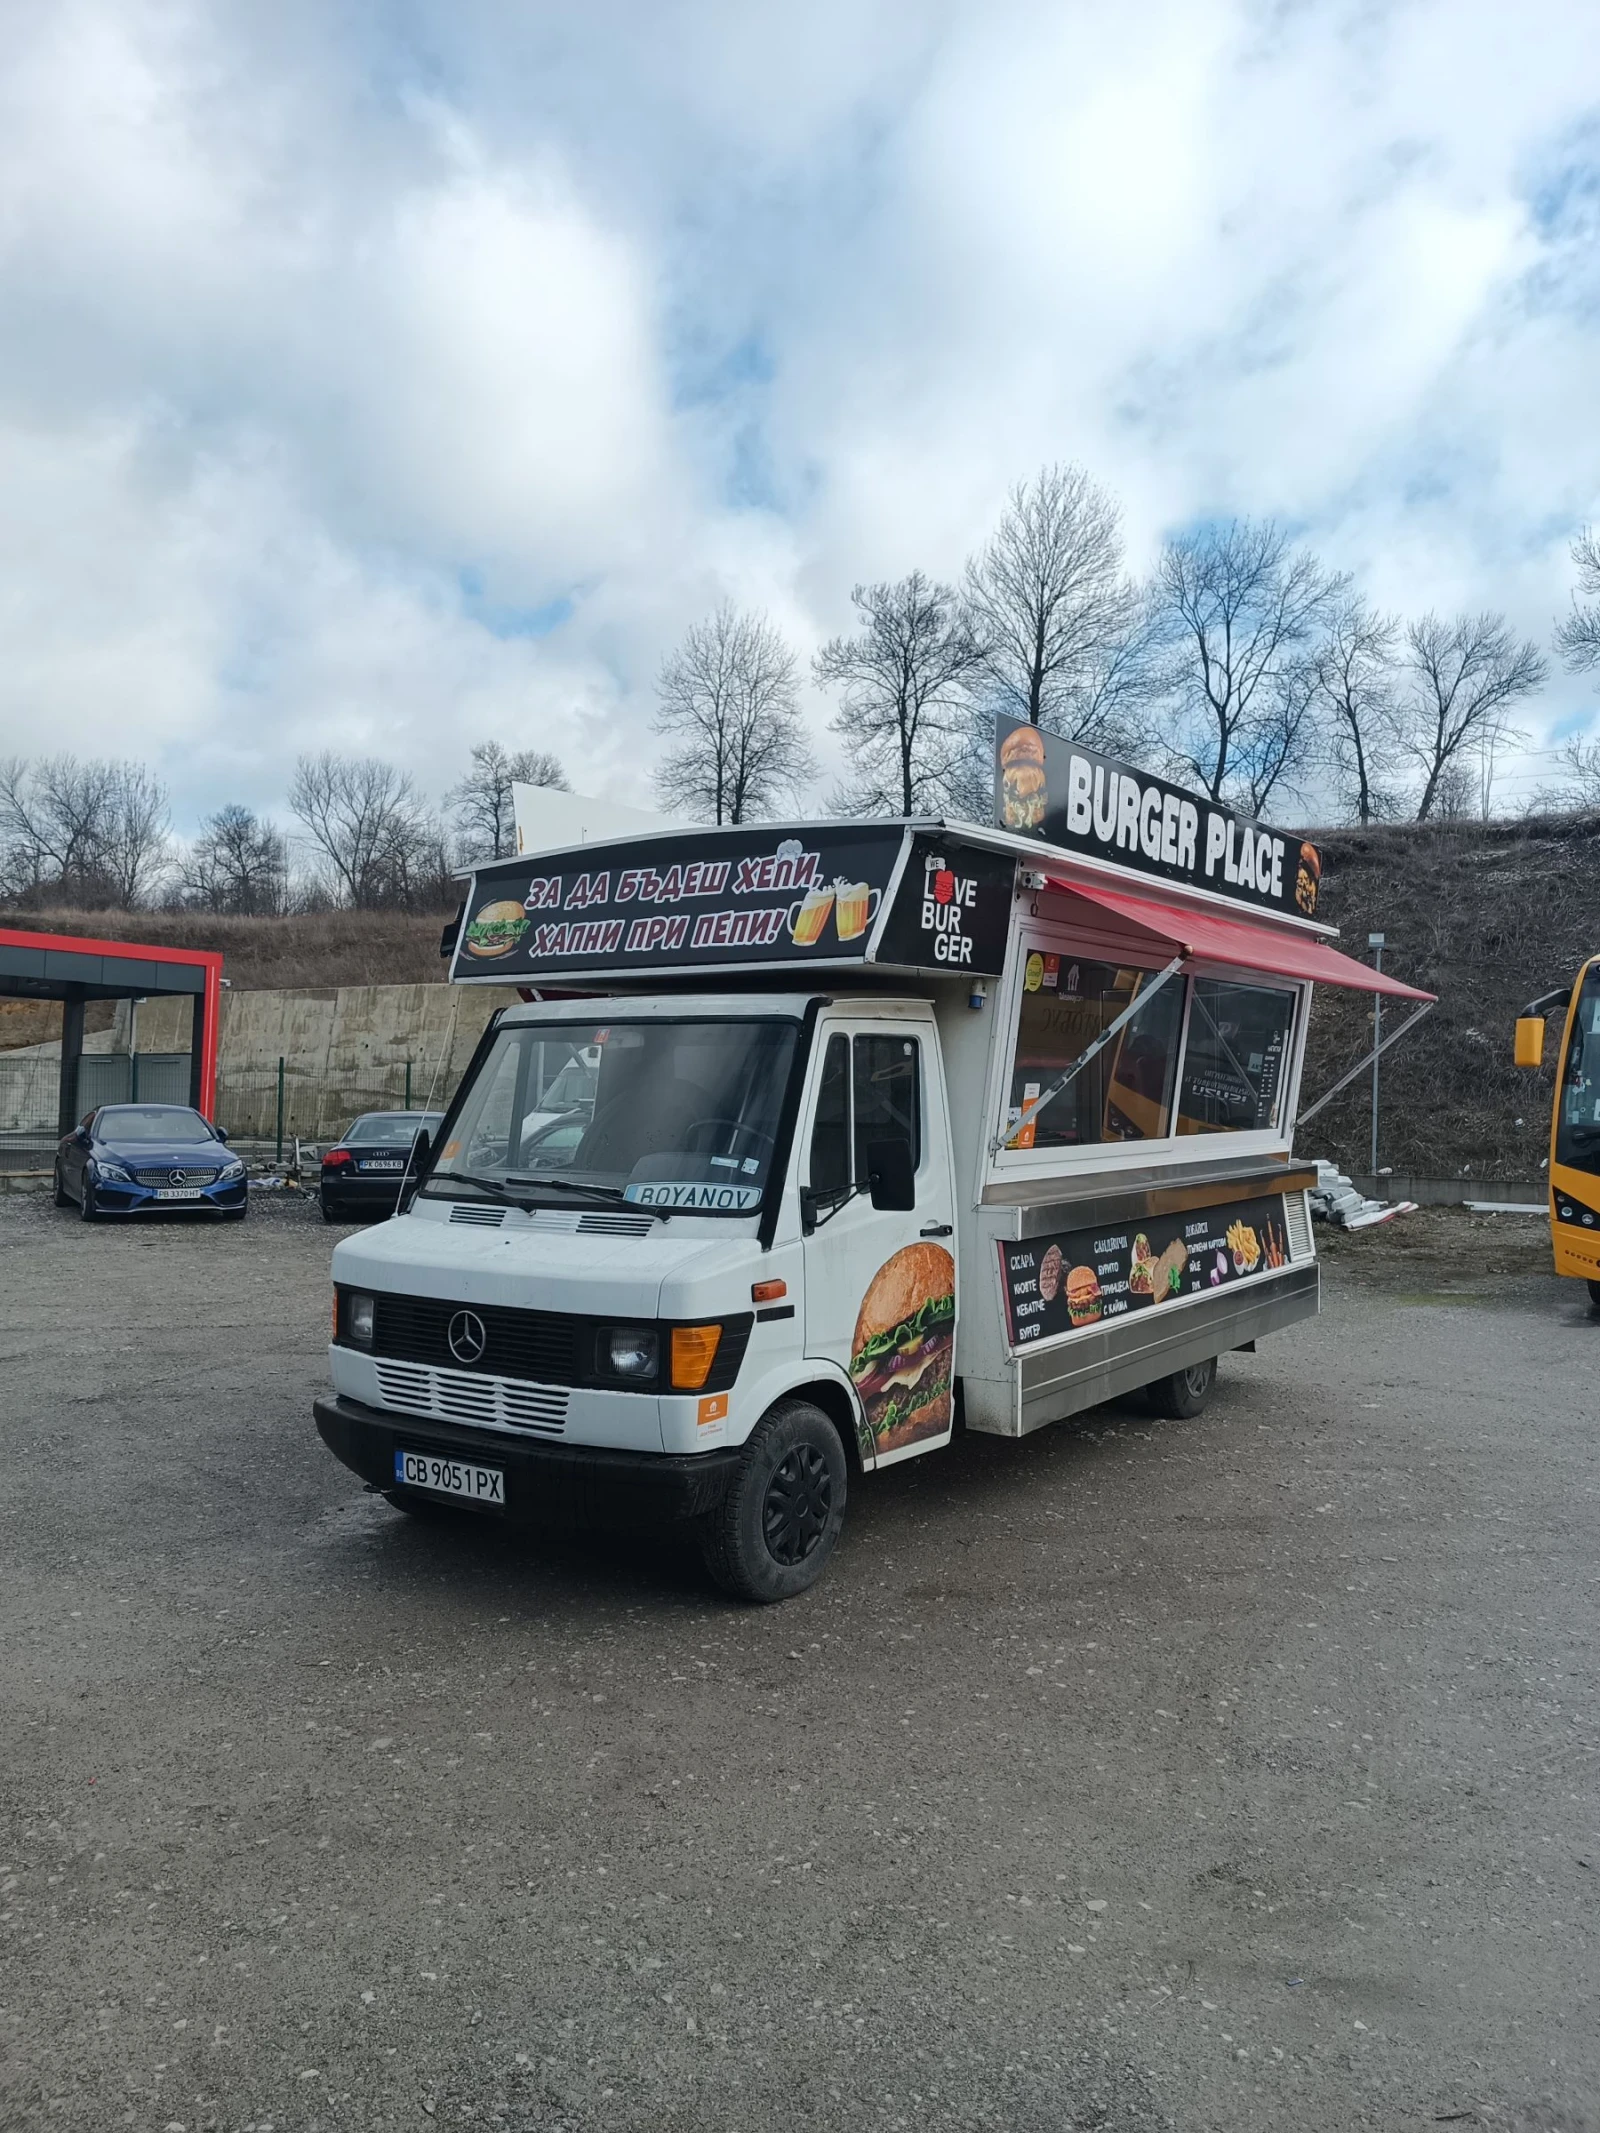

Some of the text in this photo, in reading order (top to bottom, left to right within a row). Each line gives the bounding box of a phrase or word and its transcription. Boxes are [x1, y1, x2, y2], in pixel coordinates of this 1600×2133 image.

[1067, 754, 1285, 898] BURGER PLACE
[930, 860, 939, 868] WE
[523, 852, 824, 910] ЗА ДА БЪДЕШ ХЕПИ,
[921, 901, 961, 933] BUR
[529, 908, 788, 958] ХАПНИ ПРИ ПЕПИ!
[934, 933, 973, 963] GER
[640, 1187, 750, 1208] BOYANOV
[1094, 1236, 1128, 1253] САНДВИЧИ
[1010, 1252, 1035, 1270] СКАРА
[1098, 1262, 1119, 1275] БУРИТО
[1014, 1279, 1037, 1295] КЮФТЕ
[1100, 1280, 1129, 1296] ПРИНЦЕСА
[1016, 1299, 1046, 1317] КЕБАПЧЕ
[1103, 1299, 1128, 1315] С КАЙМА
[1019, 1324, 1040, 1340] БУРГЕР
[406, 1457, 428, 1483] CB
[431, 1462, 471, 1493] 9051
[476, 1471, 500, 1499] PX
